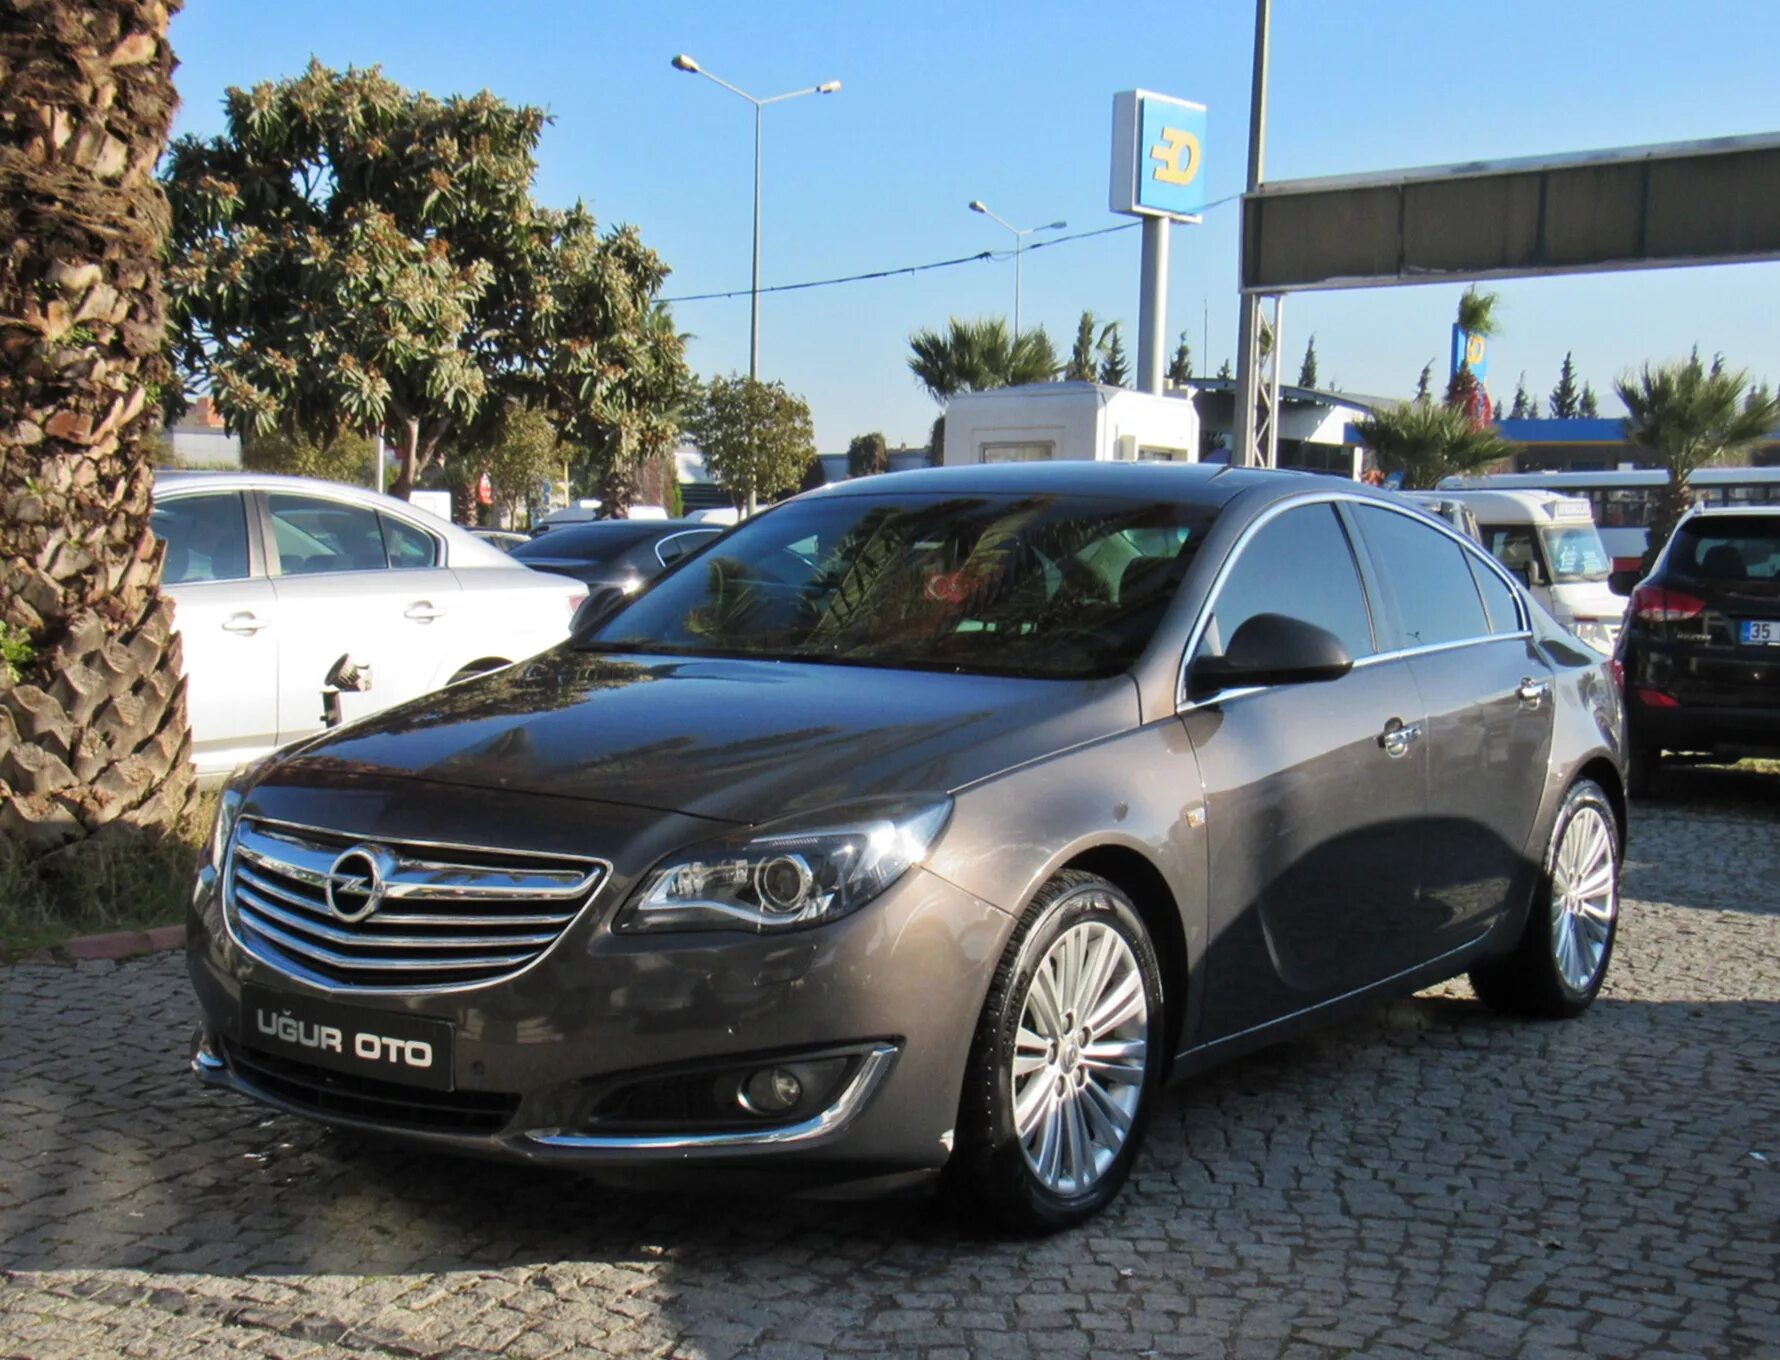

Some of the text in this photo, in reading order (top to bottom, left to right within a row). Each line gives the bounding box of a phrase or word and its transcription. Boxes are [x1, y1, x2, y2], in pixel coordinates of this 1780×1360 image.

[1751, 622, 1771, 640] 35
[257, 1009, 432, 1068] UĞUR OTO
